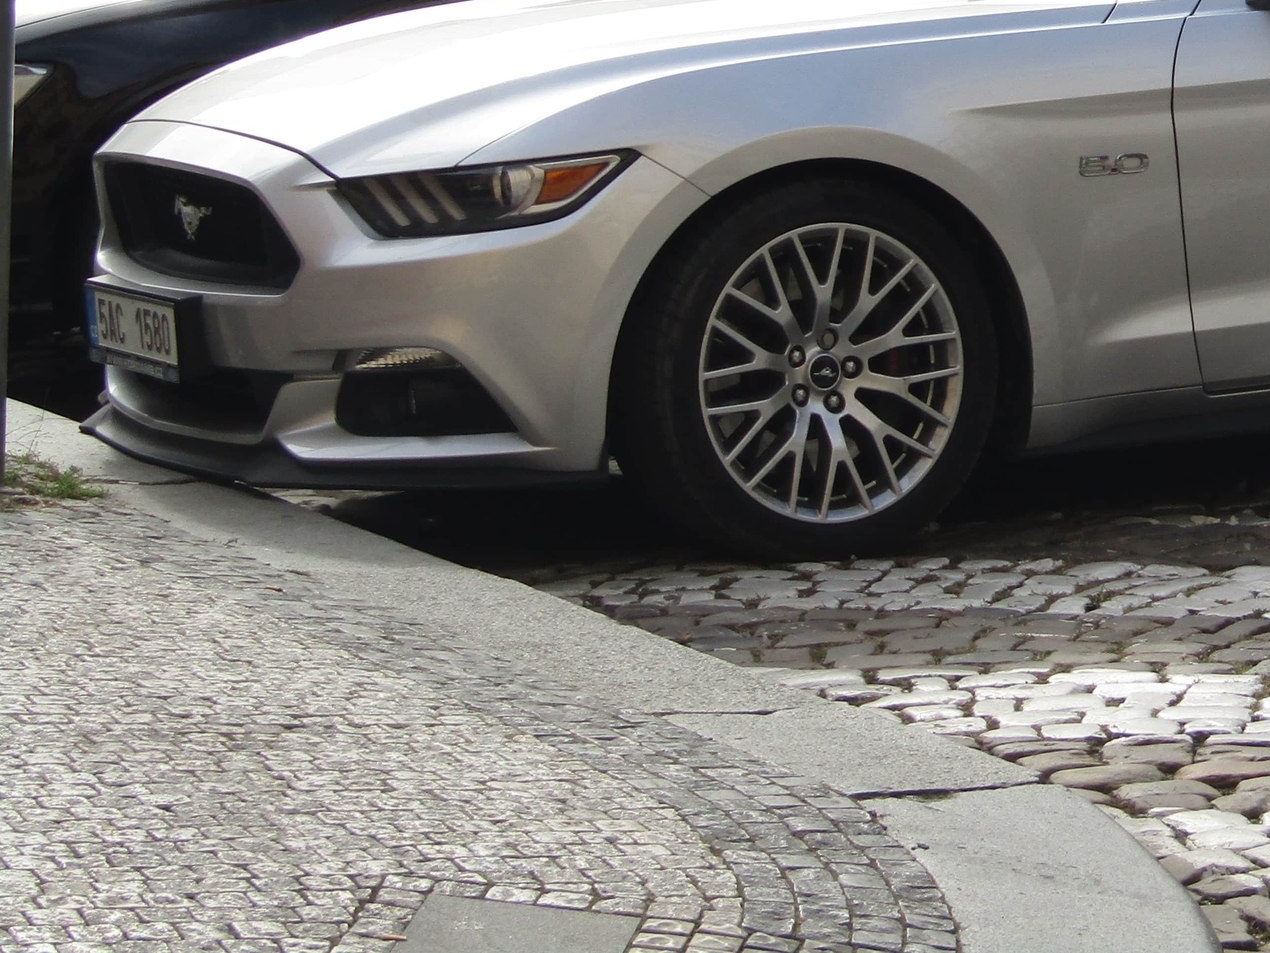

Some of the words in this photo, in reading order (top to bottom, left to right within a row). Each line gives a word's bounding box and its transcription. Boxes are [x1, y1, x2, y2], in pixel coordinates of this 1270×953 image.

[1079, 153, 1149, 178] 5.0
[98, 299, 125, 344] 5AC
[135, 306, 171, 356] 1580
